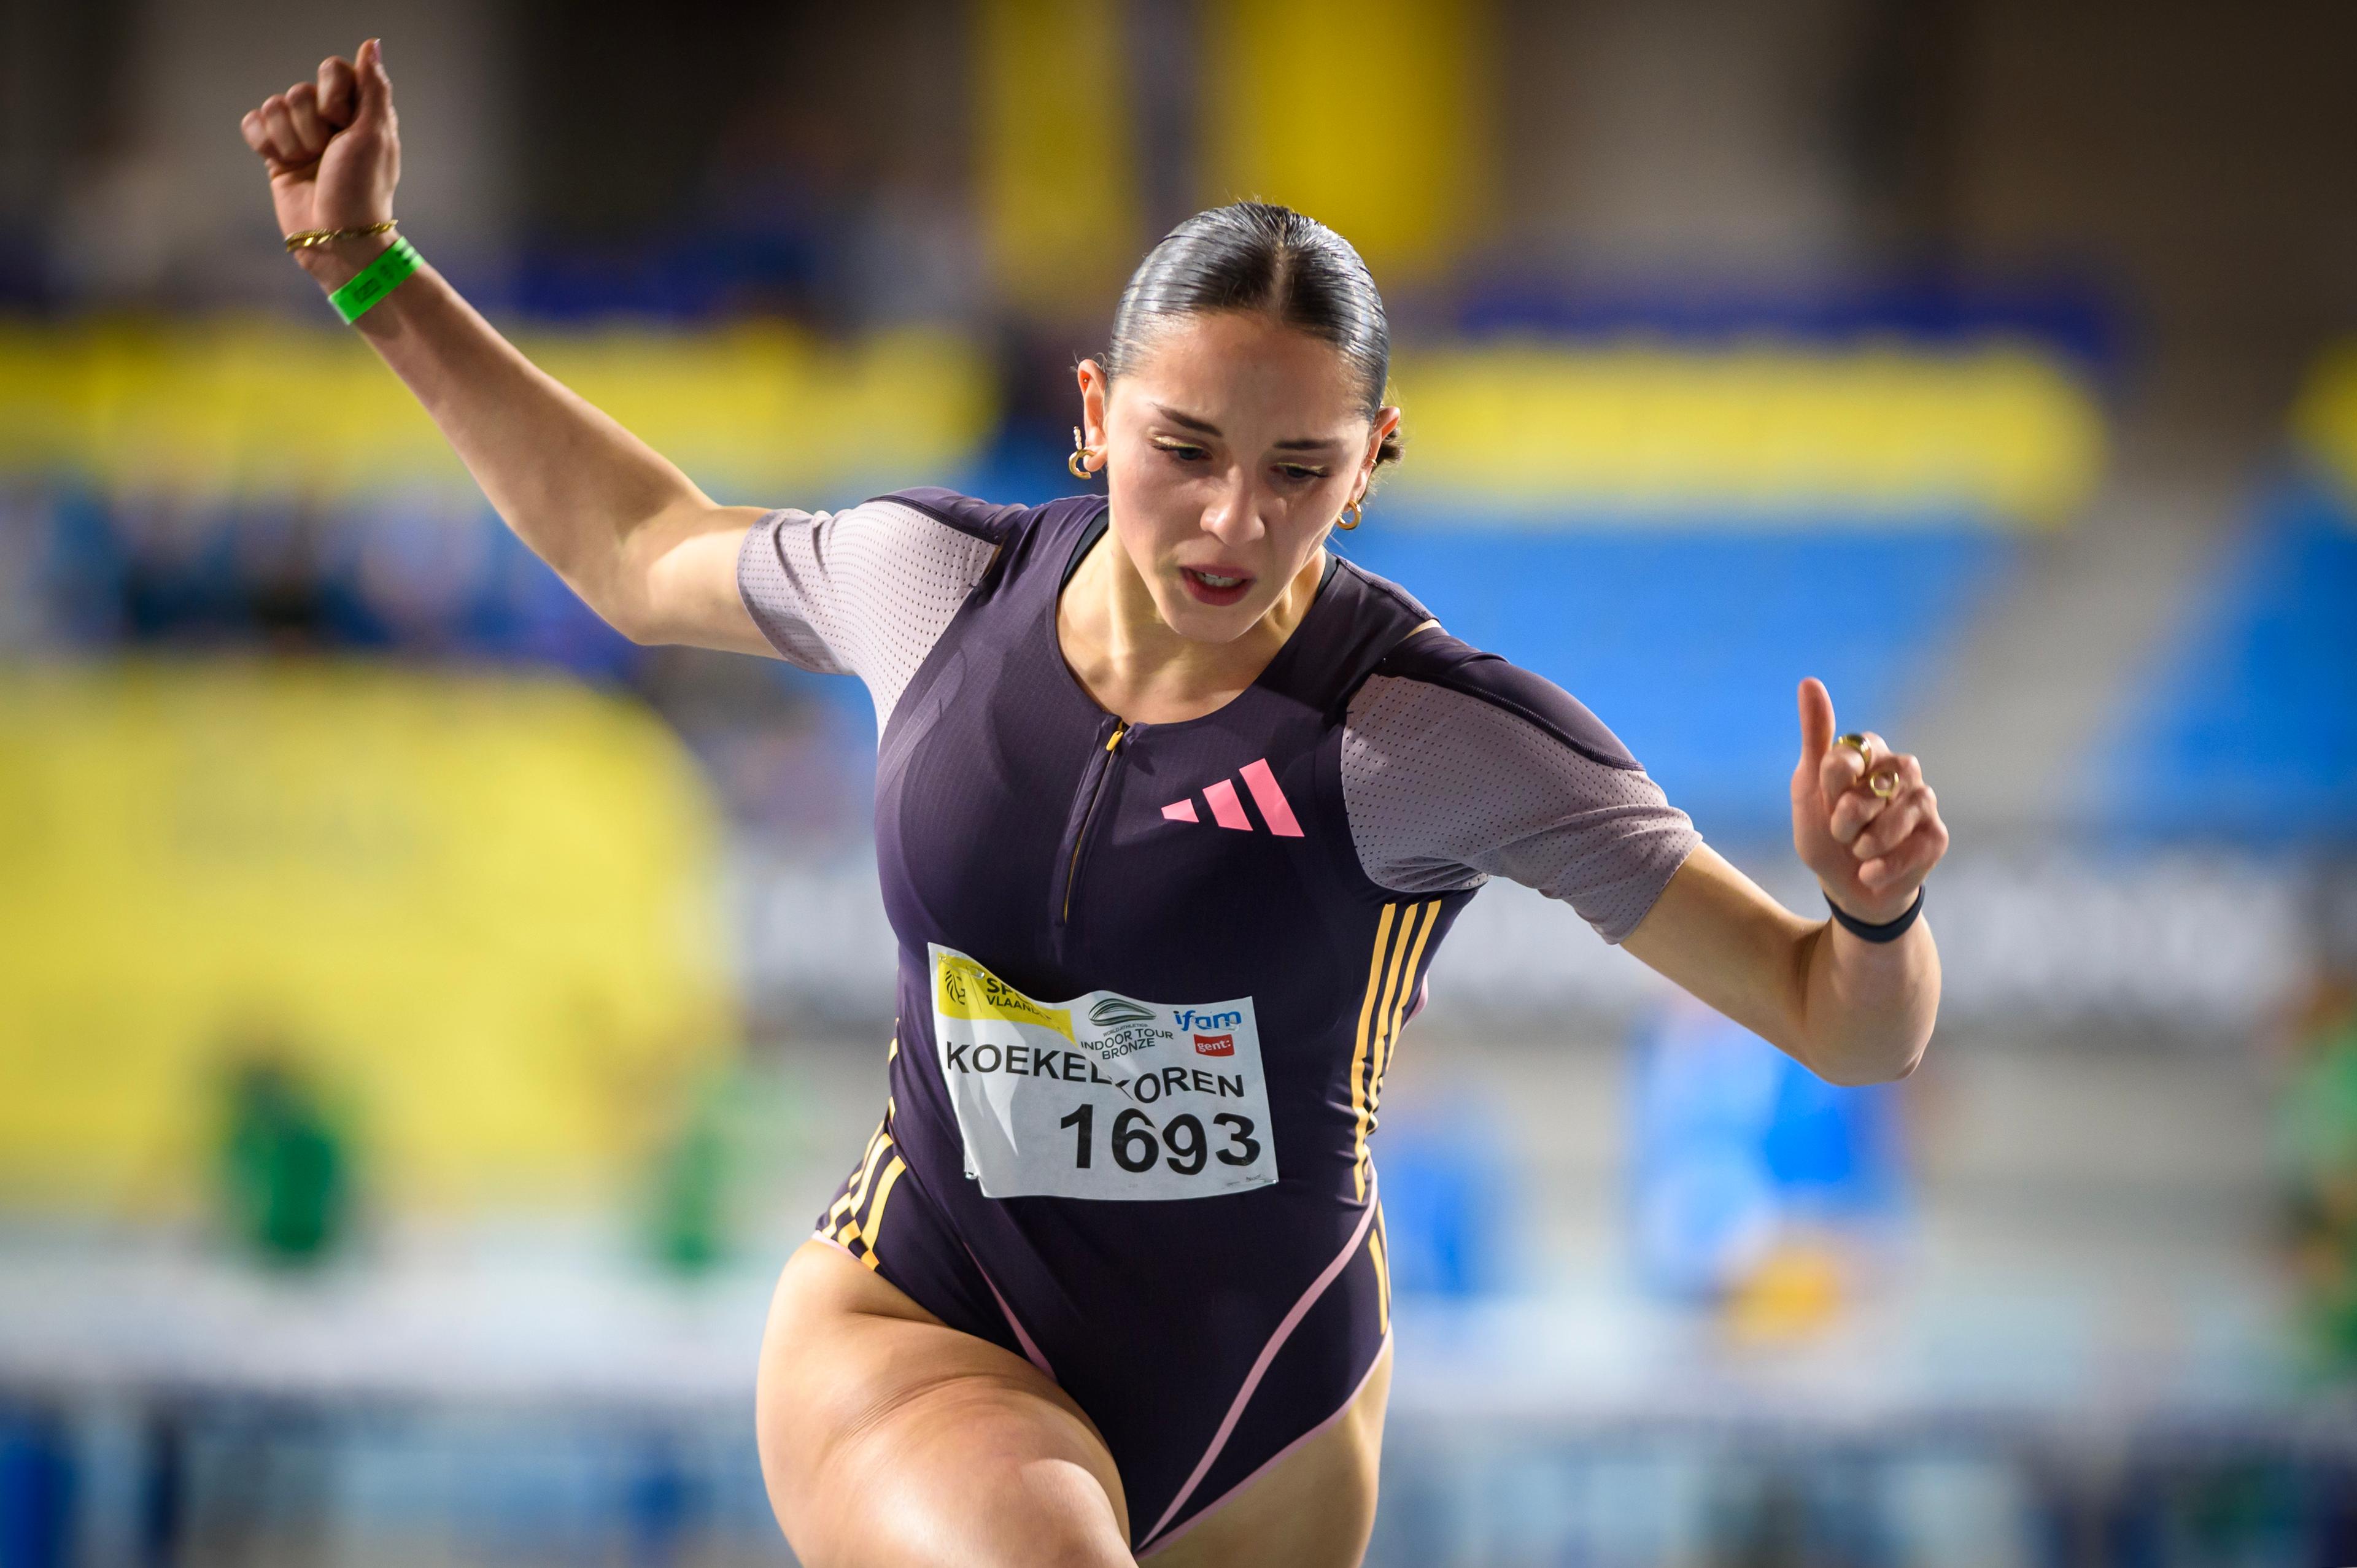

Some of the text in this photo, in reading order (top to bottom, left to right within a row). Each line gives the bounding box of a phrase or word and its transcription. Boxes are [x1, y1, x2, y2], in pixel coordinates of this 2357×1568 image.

[1173, 1010, 1242, 1032] ifam
[1080, 1028, 1174, 1051] INDOOR TOUR
[1102, 1038, 1155, 1060] BRONZE
[1060, 1103, 1261, 1175] 1693
